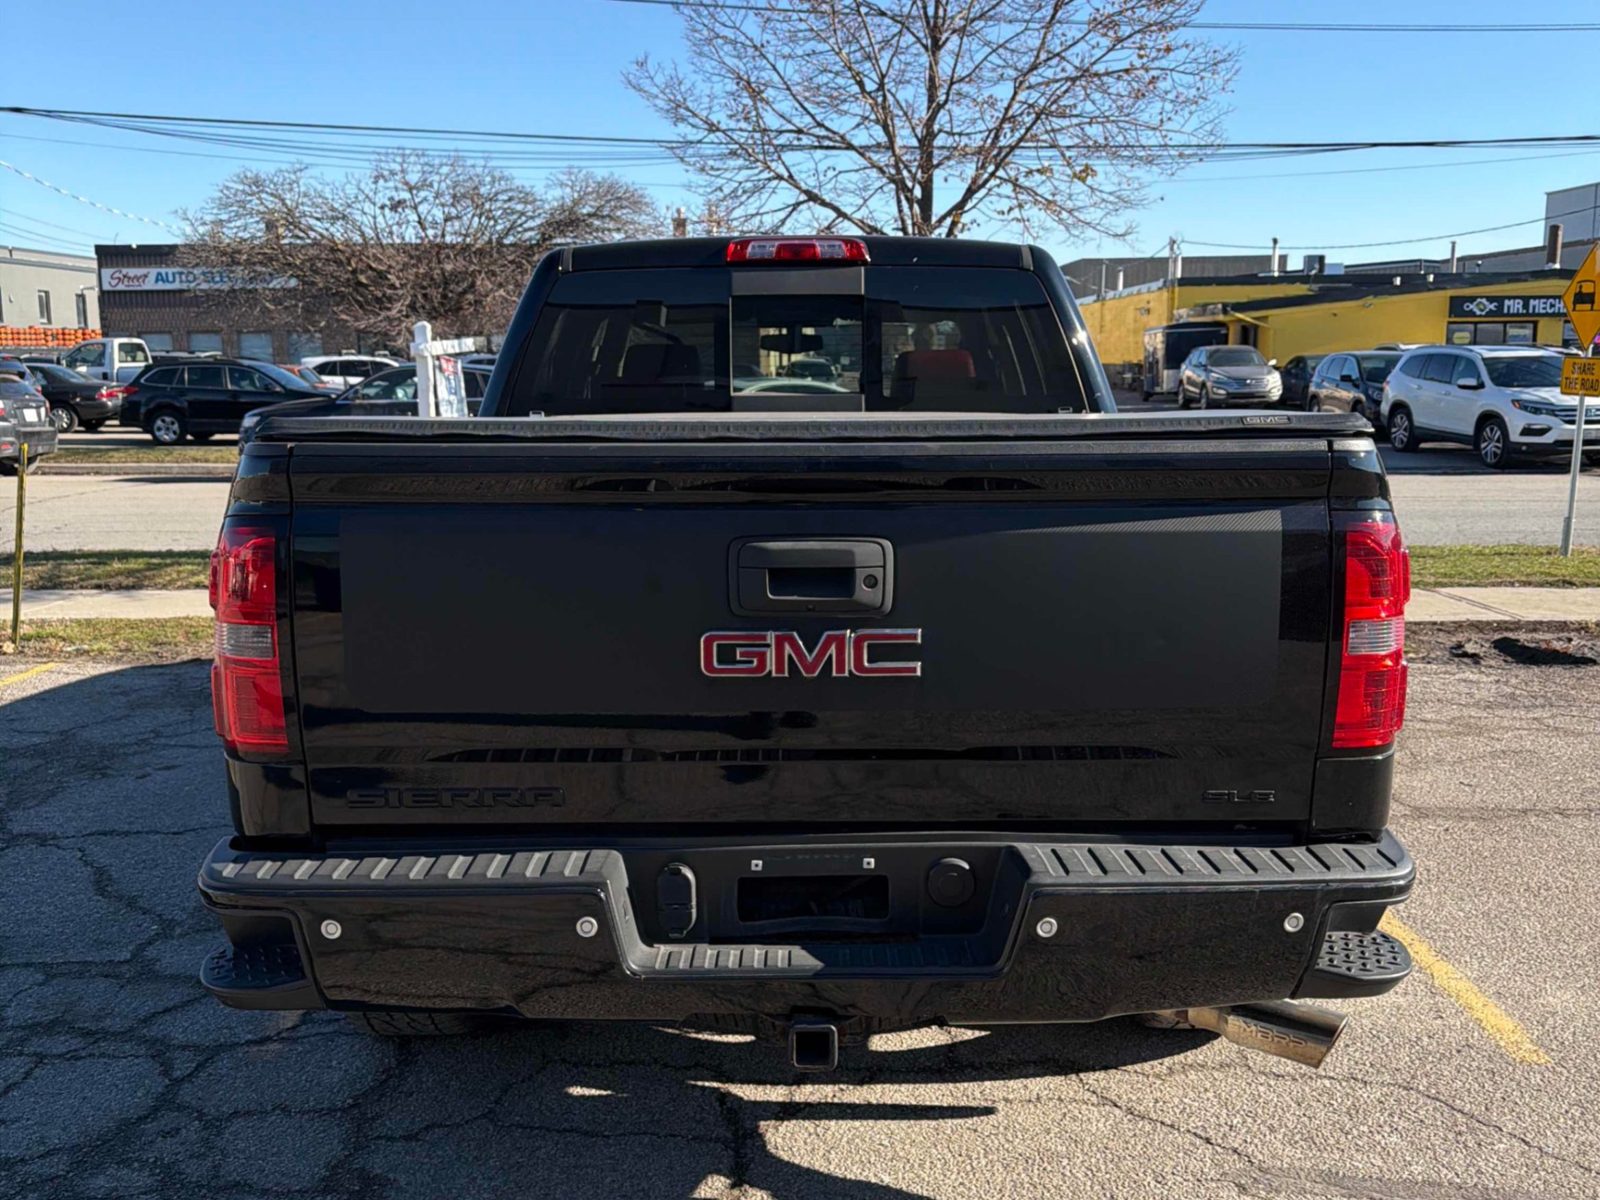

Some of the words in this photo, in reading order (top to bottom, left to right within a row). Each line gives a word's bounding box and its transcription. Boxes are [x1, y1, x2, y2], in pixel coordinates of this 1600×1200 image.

[154, 270, 197, 284] AUTO
[1503, 299, 1526, 314] MR.
[1529, 299, 1567, 314] MECH
[1571, 361, 1596, 376] SHARE
[1564, 376, 1579, 390] THE
[1580, 378, 1600, 392] ROAD
[1246, 415, 1289, 424] GMC
[700, 628, 922, 677] GMC
[346, 787, 566, 809] SIERRA
[1240, 1019, 1308, 1049] MBRP
